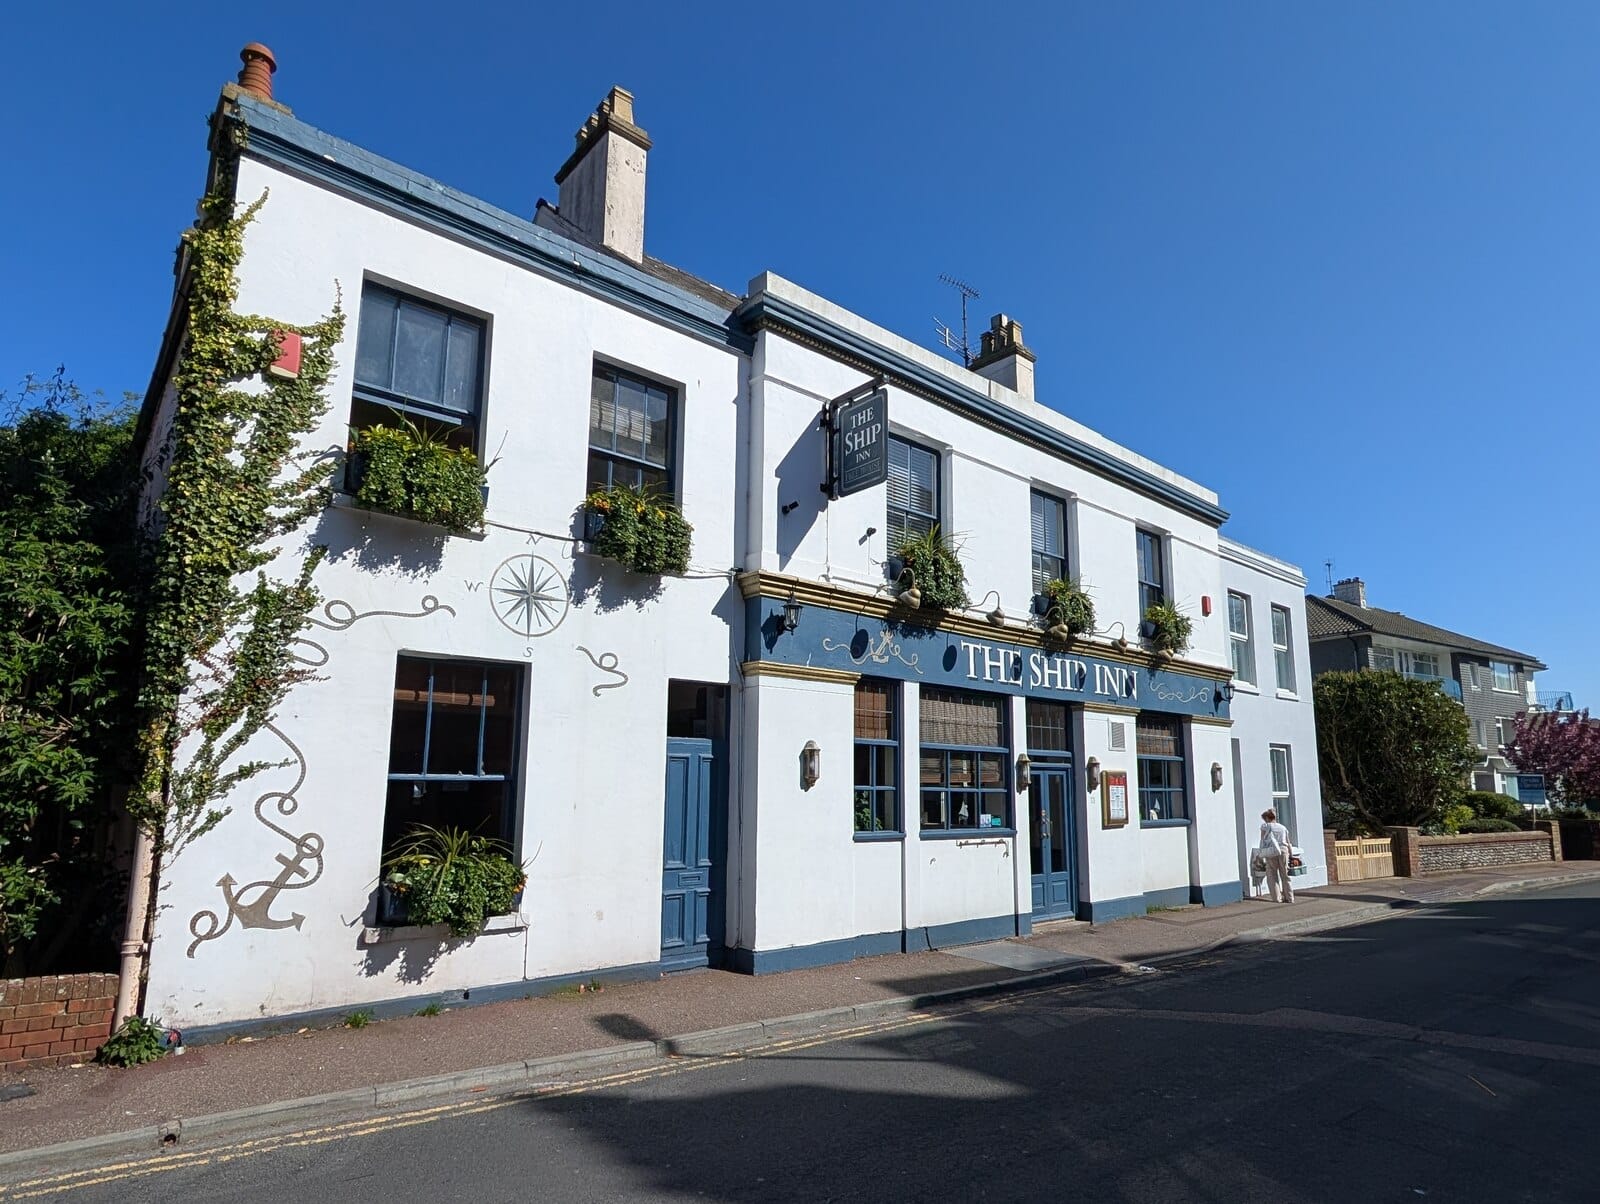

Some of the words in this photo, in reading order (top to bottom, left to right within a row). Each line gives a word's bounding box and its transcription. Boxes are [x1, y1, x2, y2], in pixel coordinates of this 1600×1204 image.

[850, 407, 874, 429] THE
[845, 423, 881, 457] SHIP
[855, 449, 871, 463] INN
[526, 533, 543, 546] N
[464, 580, 484, 592] W
[523, 647, 534, 658] S
[961, 640, 1023, 688] THE
[1029, 651, 1087, 692] SHIP
[1093, 663, 1138, 701] INN
